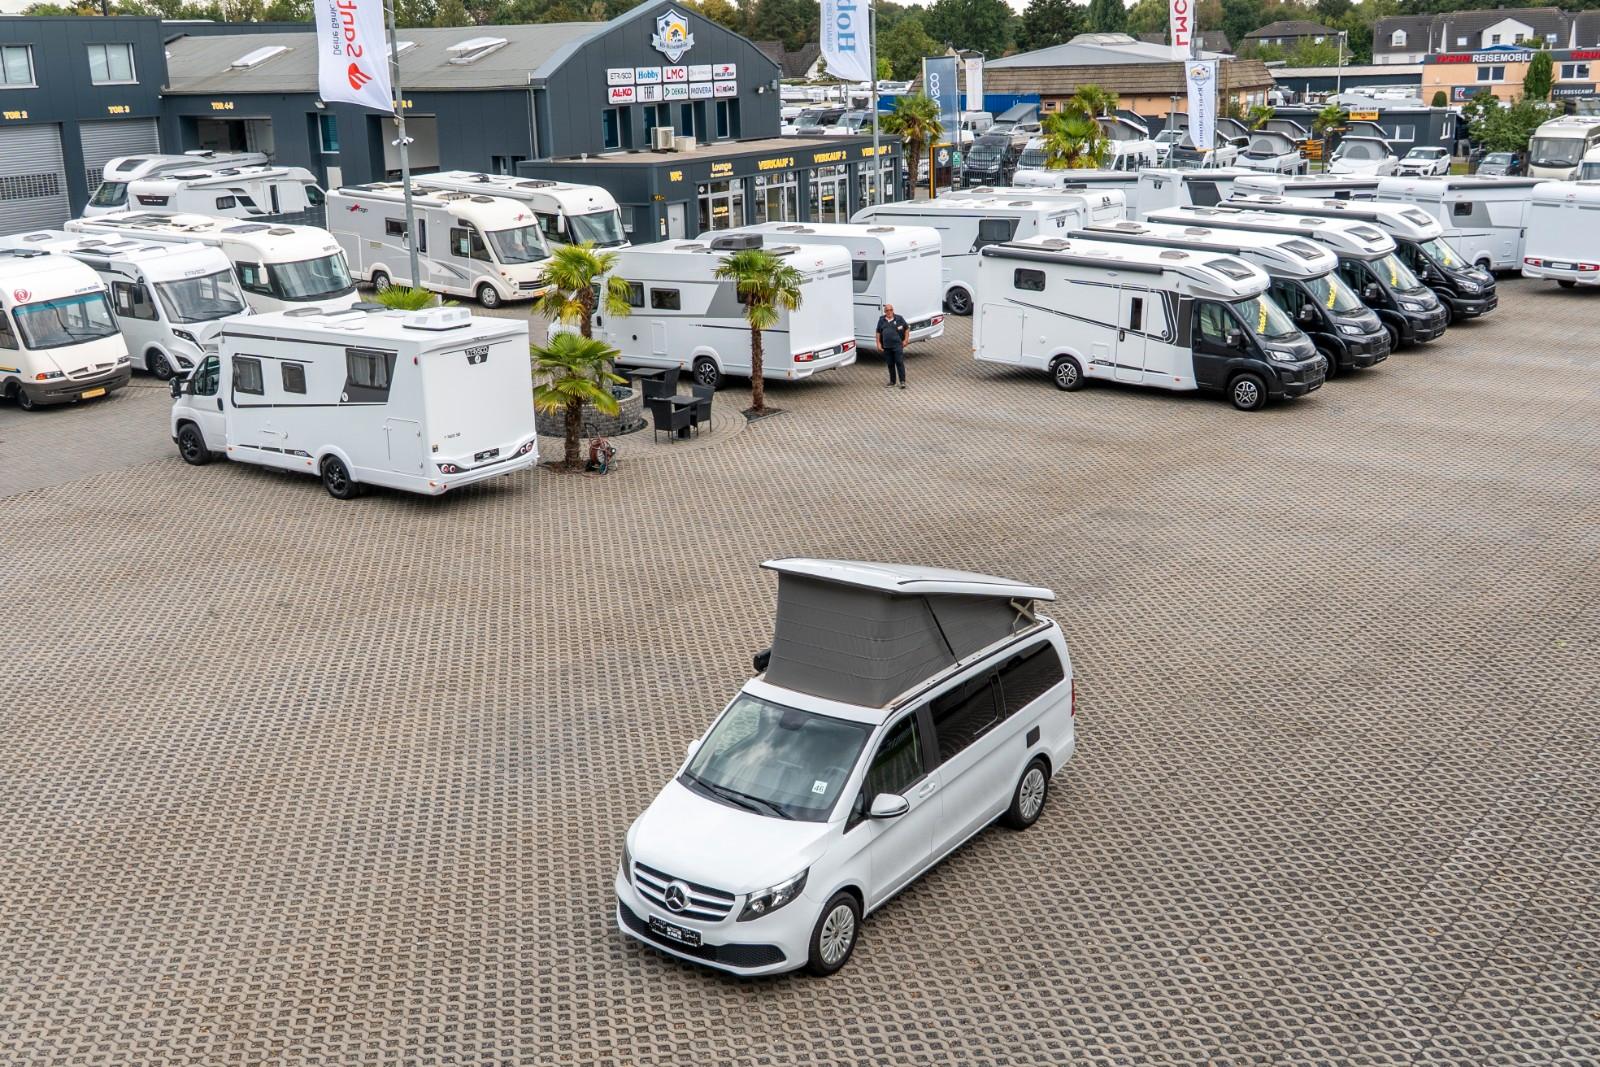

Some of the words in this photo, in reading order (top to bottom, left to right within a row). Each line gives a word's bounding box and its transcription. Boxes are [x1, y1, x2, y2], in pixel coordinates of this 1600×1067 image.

[638, 70, 659, 80] Hobby
[666, 68, 684, 79] LMC
[644, 86, 654, 99] FIAT
[671, 87, 688, 95] DEKRA
[108, 105, 124, 114] TOR
[3, 111, 20, 119] TOR
[813, 153, 841, 163] VERKAUF
[841, 151, 847, 160] 2
[712, 162, 732, 172] Lounge
[758, 157, 788, 170] VERKAUF
[789, 157, 794, 167] 3
[670, 171, 683, 182] WC
